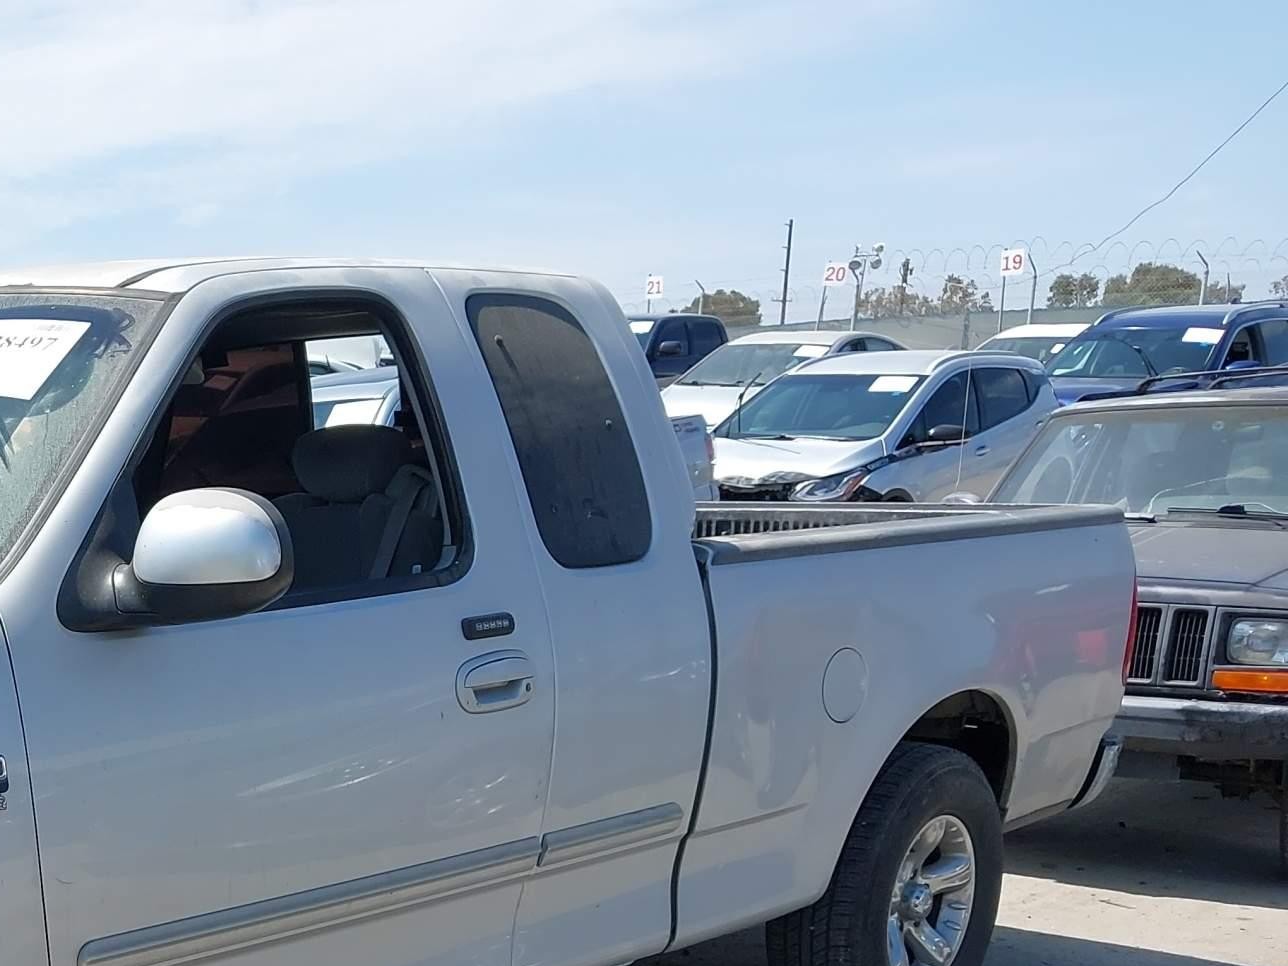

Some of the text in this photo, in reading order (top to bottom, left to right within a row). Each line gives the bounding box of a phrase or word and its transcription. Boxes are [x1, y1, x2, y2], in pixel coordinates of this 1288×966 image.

[1001, 254, 1023, 272] 19
[824, 266, 846, 282] 20
[647, 280, 662, 295] 21
